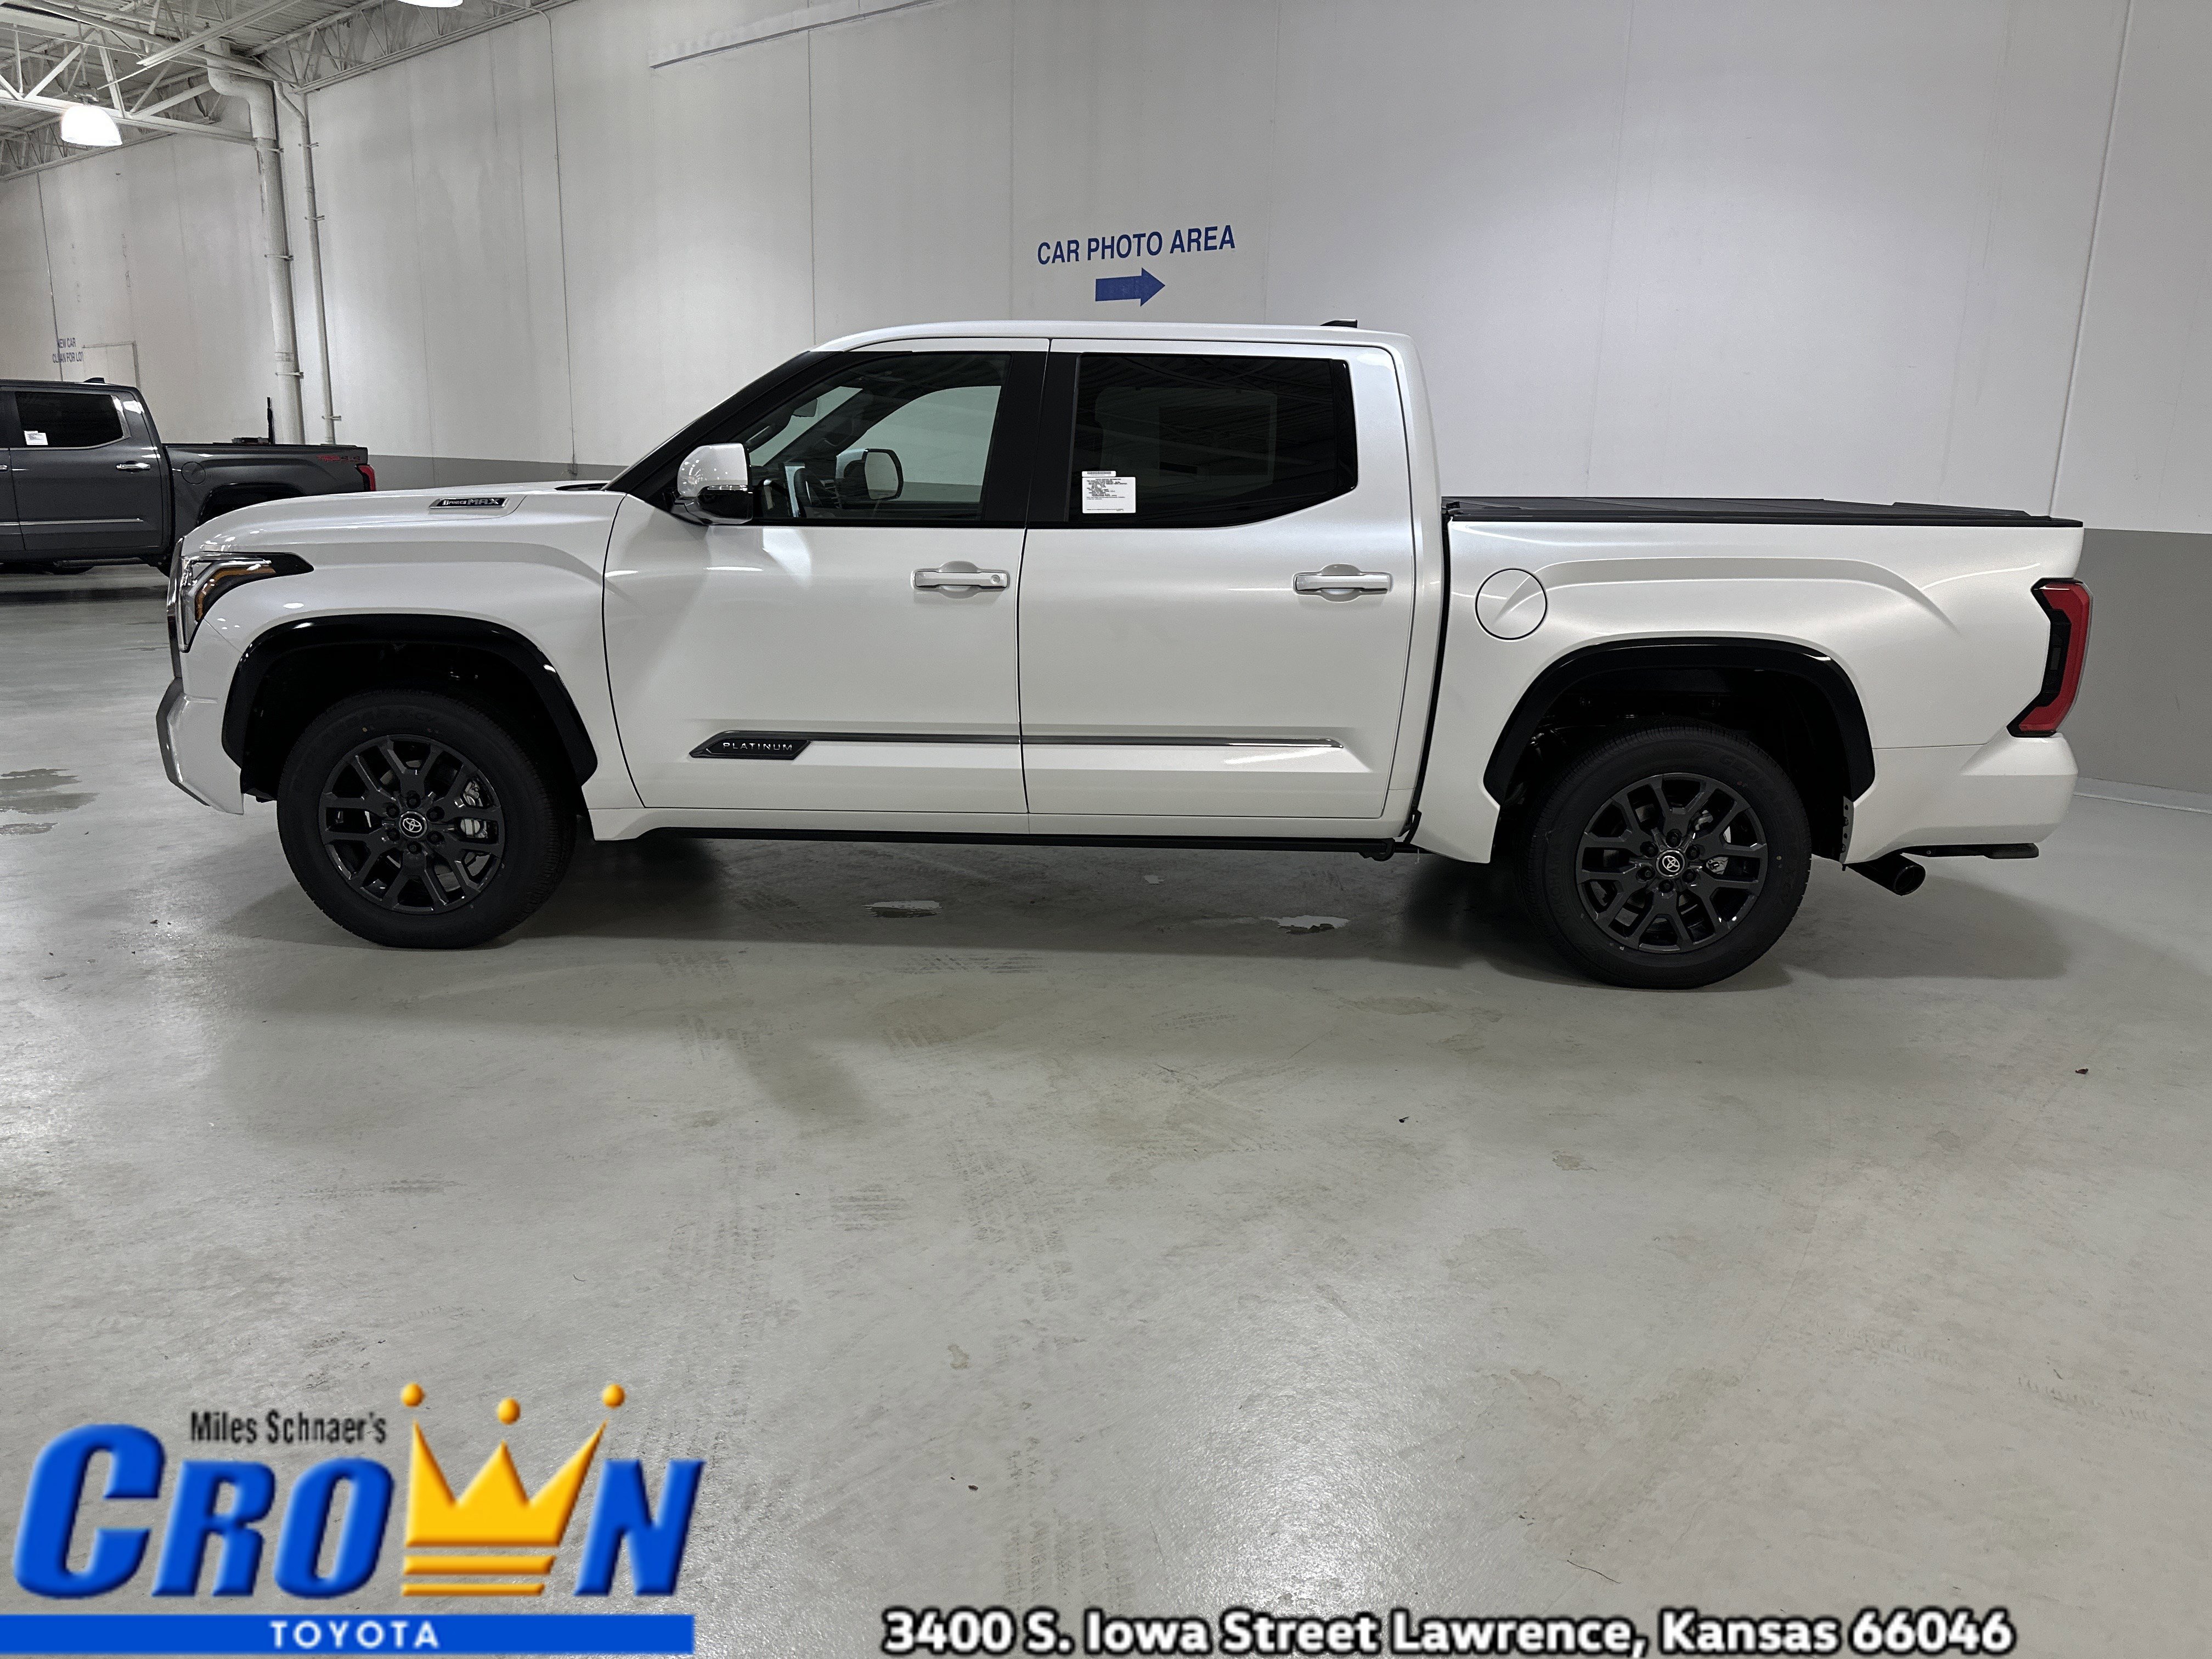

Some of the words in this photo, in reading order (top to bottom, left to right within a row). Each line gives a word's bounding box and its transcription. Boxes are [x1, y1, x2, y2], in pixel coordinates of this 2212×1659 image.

[1037, 239, 1080, 265] CAR
[1087, 231, 1163, 261] PHOTO
[1170, 225, 1235, 254] AREA
[723, 742, 793, 751] PLATINUM
